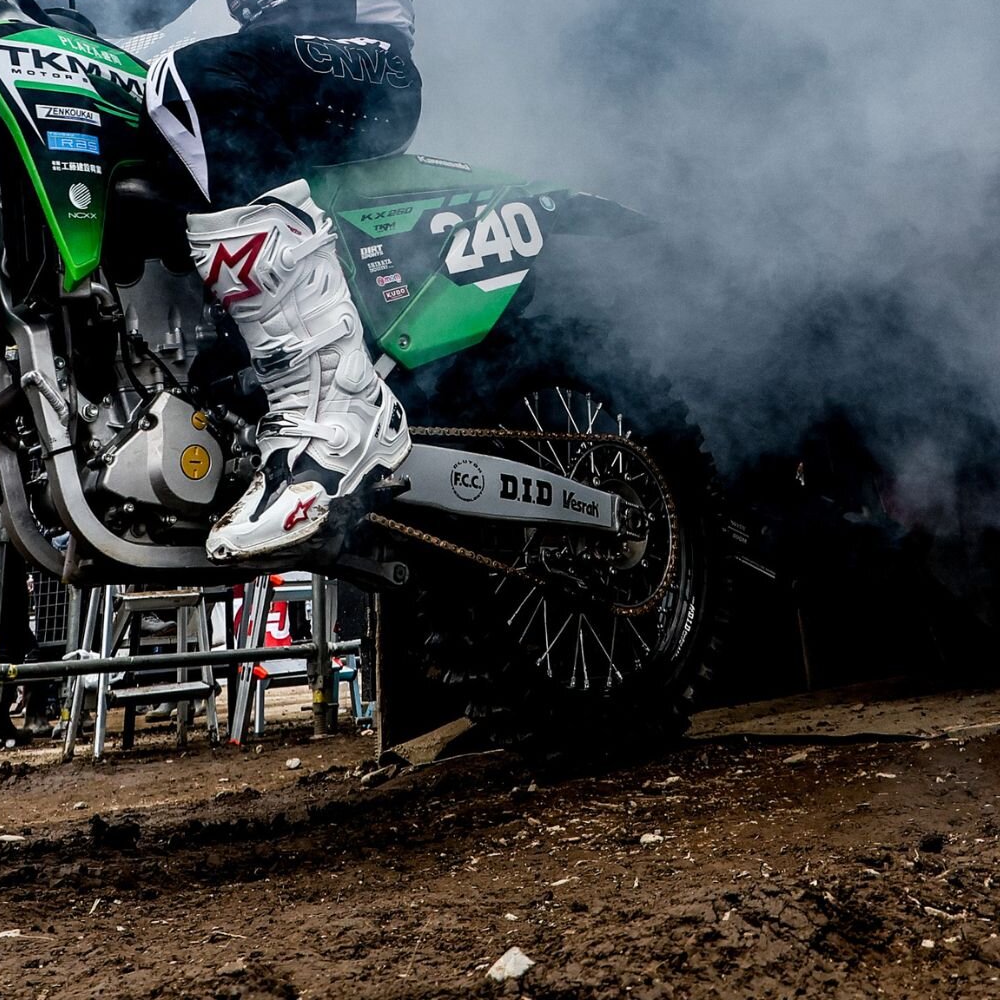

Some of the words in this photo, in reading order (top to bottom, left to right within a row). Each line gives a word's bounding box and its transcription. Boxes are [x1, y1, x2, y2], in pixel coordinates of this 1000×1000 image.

[58, 35, 99, 58] PLAZA
[11, 68, 72, 80] MOTOR
[45, 107, 93, 119] ZENKOUKAI
[430, 202, 543, 274] 240
[360, 244, 383, 256] DIRT
[453, 471, 482, 490] F.C.C.
[500, 474, 553, 507] D.I.D
[562, 489, 599, 518] Vesrah
